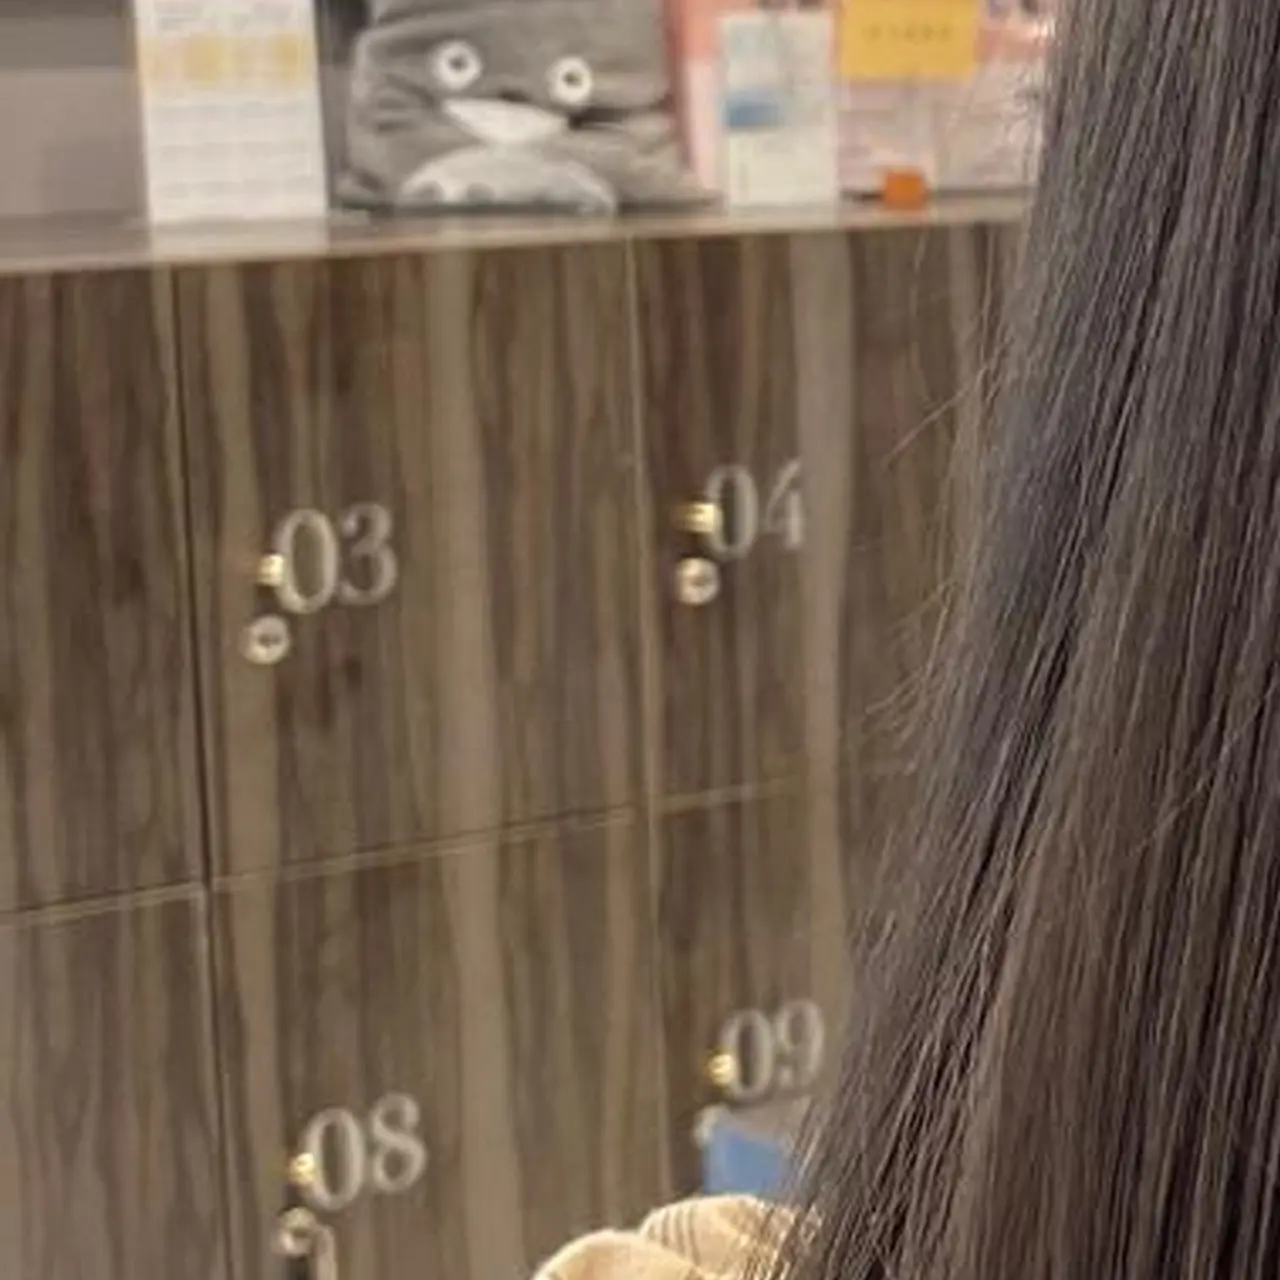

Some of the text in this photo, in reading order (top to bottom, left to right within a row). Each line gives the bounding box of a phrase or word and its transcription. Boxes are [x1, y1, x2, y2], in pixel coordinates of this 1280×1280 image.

[272, 501, 397, 614] 03
[704, 458, 807, 561] 04
[719, 999, 825, 1099] 09
[299, 1091, 427, 1211] 08
